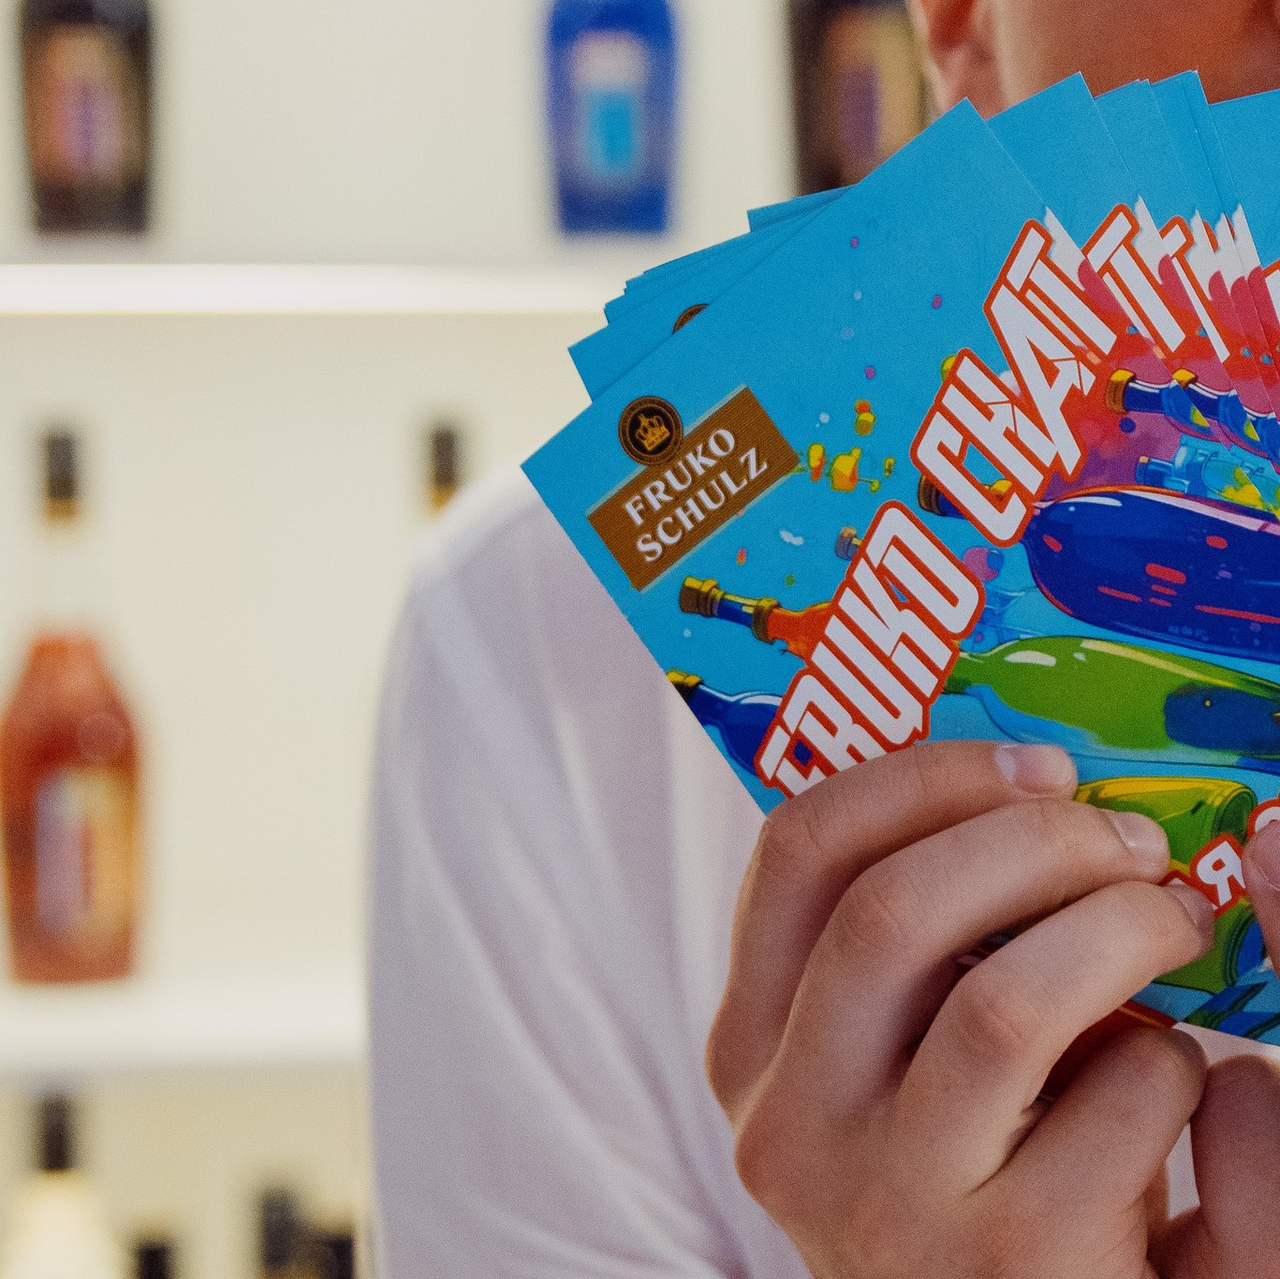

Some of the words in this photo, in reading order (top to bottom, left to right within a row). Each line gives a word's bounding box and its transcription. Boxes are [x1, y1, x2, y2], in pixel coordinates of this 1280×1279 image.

[624, 428, 736, 527] FRUKO
[635, 447, 768, 562] SCHULZ
[759, 506, 980, 797] FRUKO
